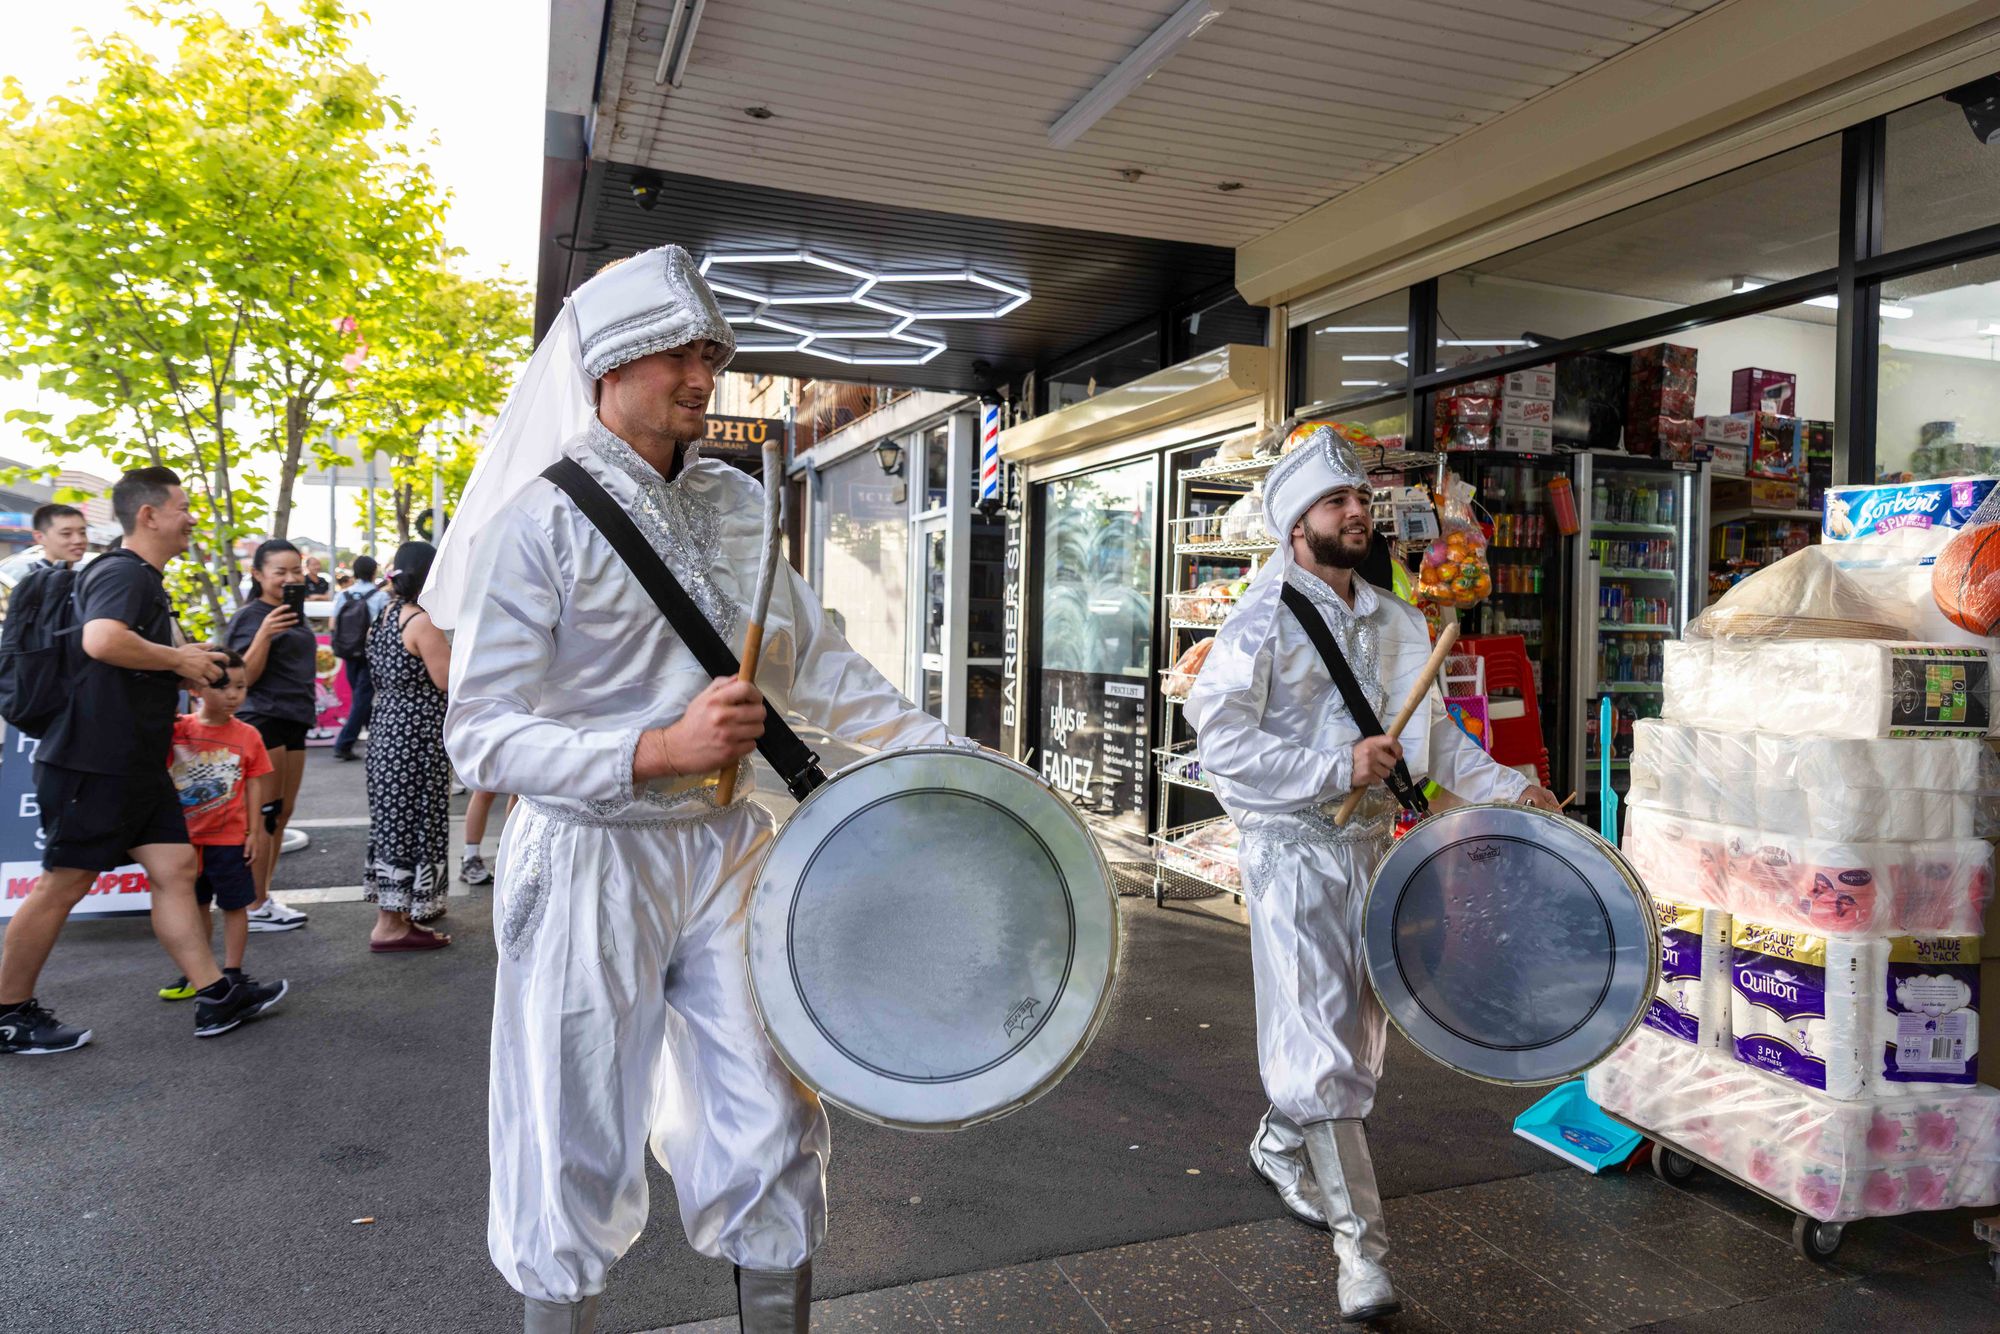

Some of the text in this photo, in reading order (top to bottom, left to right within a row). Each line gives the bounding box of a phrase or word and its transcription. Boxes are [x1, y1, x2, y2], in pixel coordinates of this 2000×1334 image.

[705, 419, 768, 443] PHÚ
[702, 440, 749, 450] ESTAURANT
[1955, 489, 1969, 501] 16
[1857, 491, 1941, 530] Sorbent
[1879, 515, 1907, 532] 3 PLY
[1003, 582, 1018, 727] BARBER
[1076, 711, 1088, 731] OF
[1042, 749, 1094, 799] FADEZ
[1654, 902, 1678, 917] ALUE
[1658, 913, 1678, 926] ACK
[1762, 942, 1795, 959] PACK
[1932, 940, 1960, 951] VALUE
[1932, 951, 1960, 962] PACK
[1740, 969, 1798, 1003] Quilton
[1006, 1001, 1032, 1028] REMO
[1757, 1045, 1782, 1060] 3 PLY
